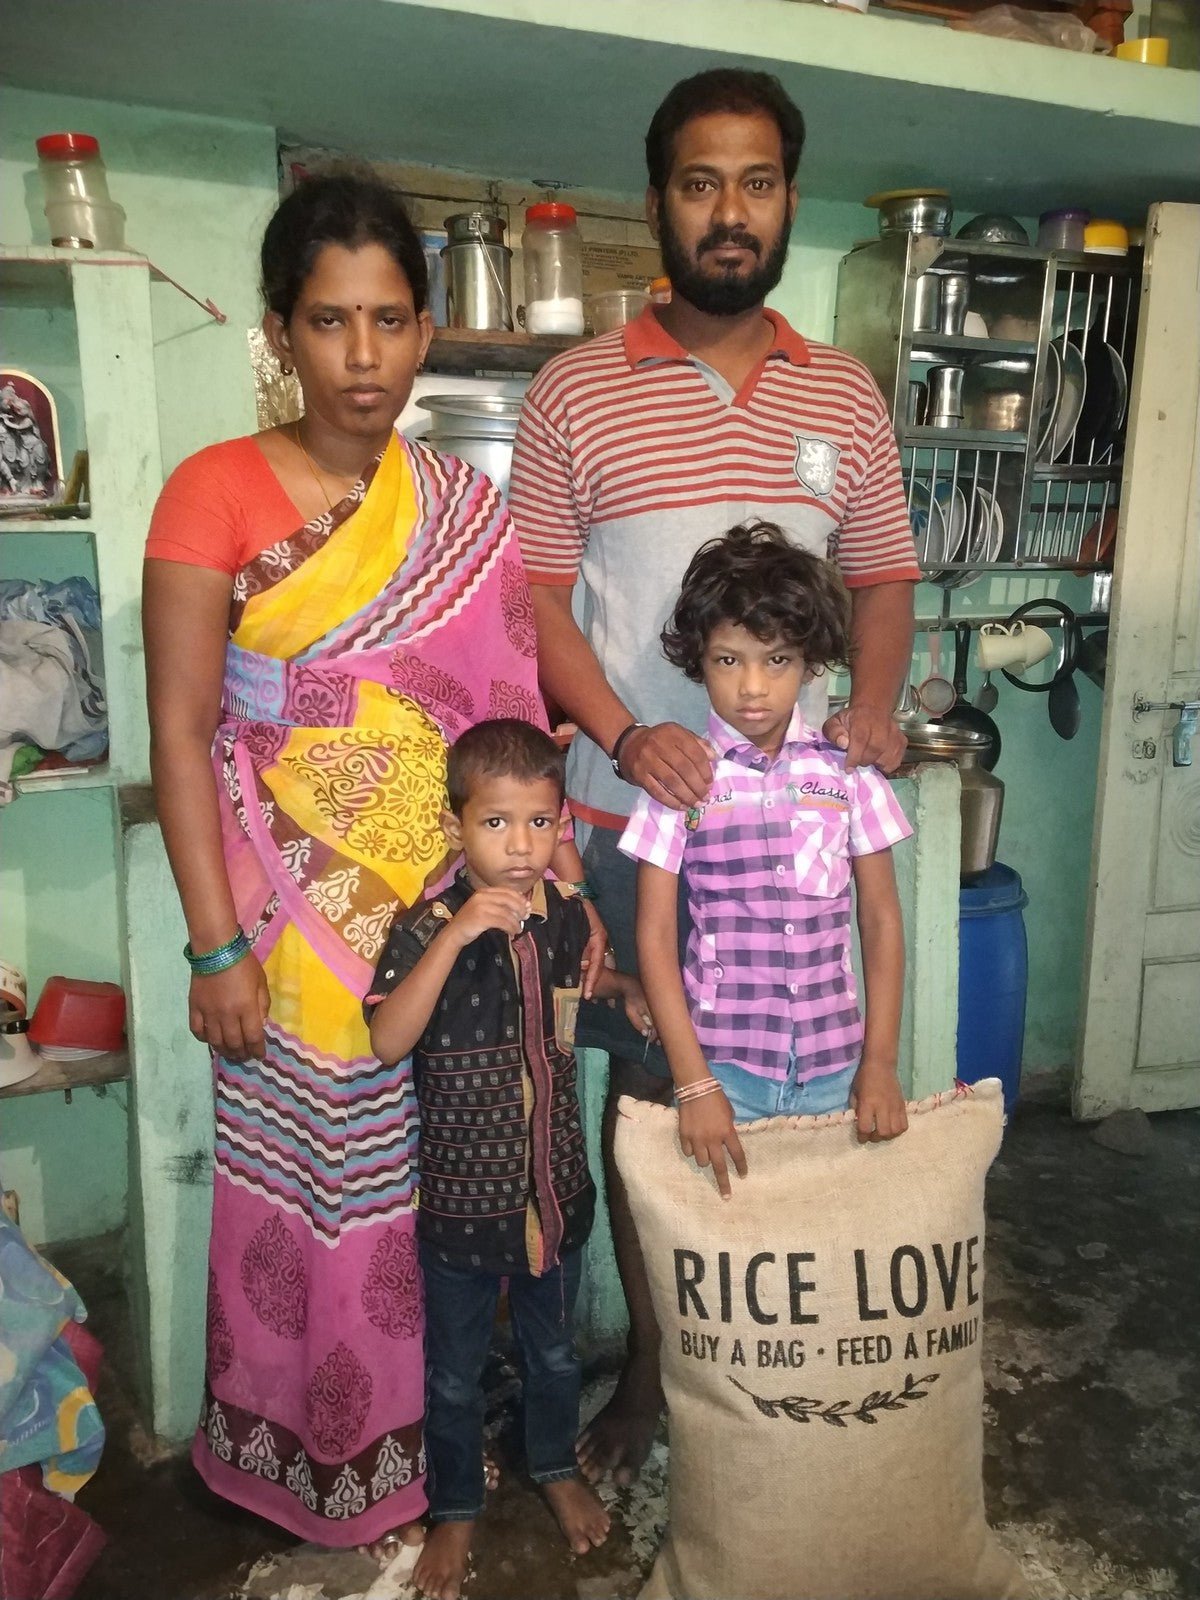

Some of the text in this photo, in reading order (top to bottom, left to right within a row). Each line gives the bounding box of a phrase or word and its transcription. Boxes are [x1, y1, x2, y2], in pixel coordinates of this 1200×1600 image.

[673, 1235, 979, 1325] RICE LOVE
[680, 1329, 720, 1362] BUY
[730, 1338, 746, 1367] A
[757, 1339, 805, 1368] BAG
[836, 1334, 892, 1366] FEED
[904, 1332, 919, 1360] A
